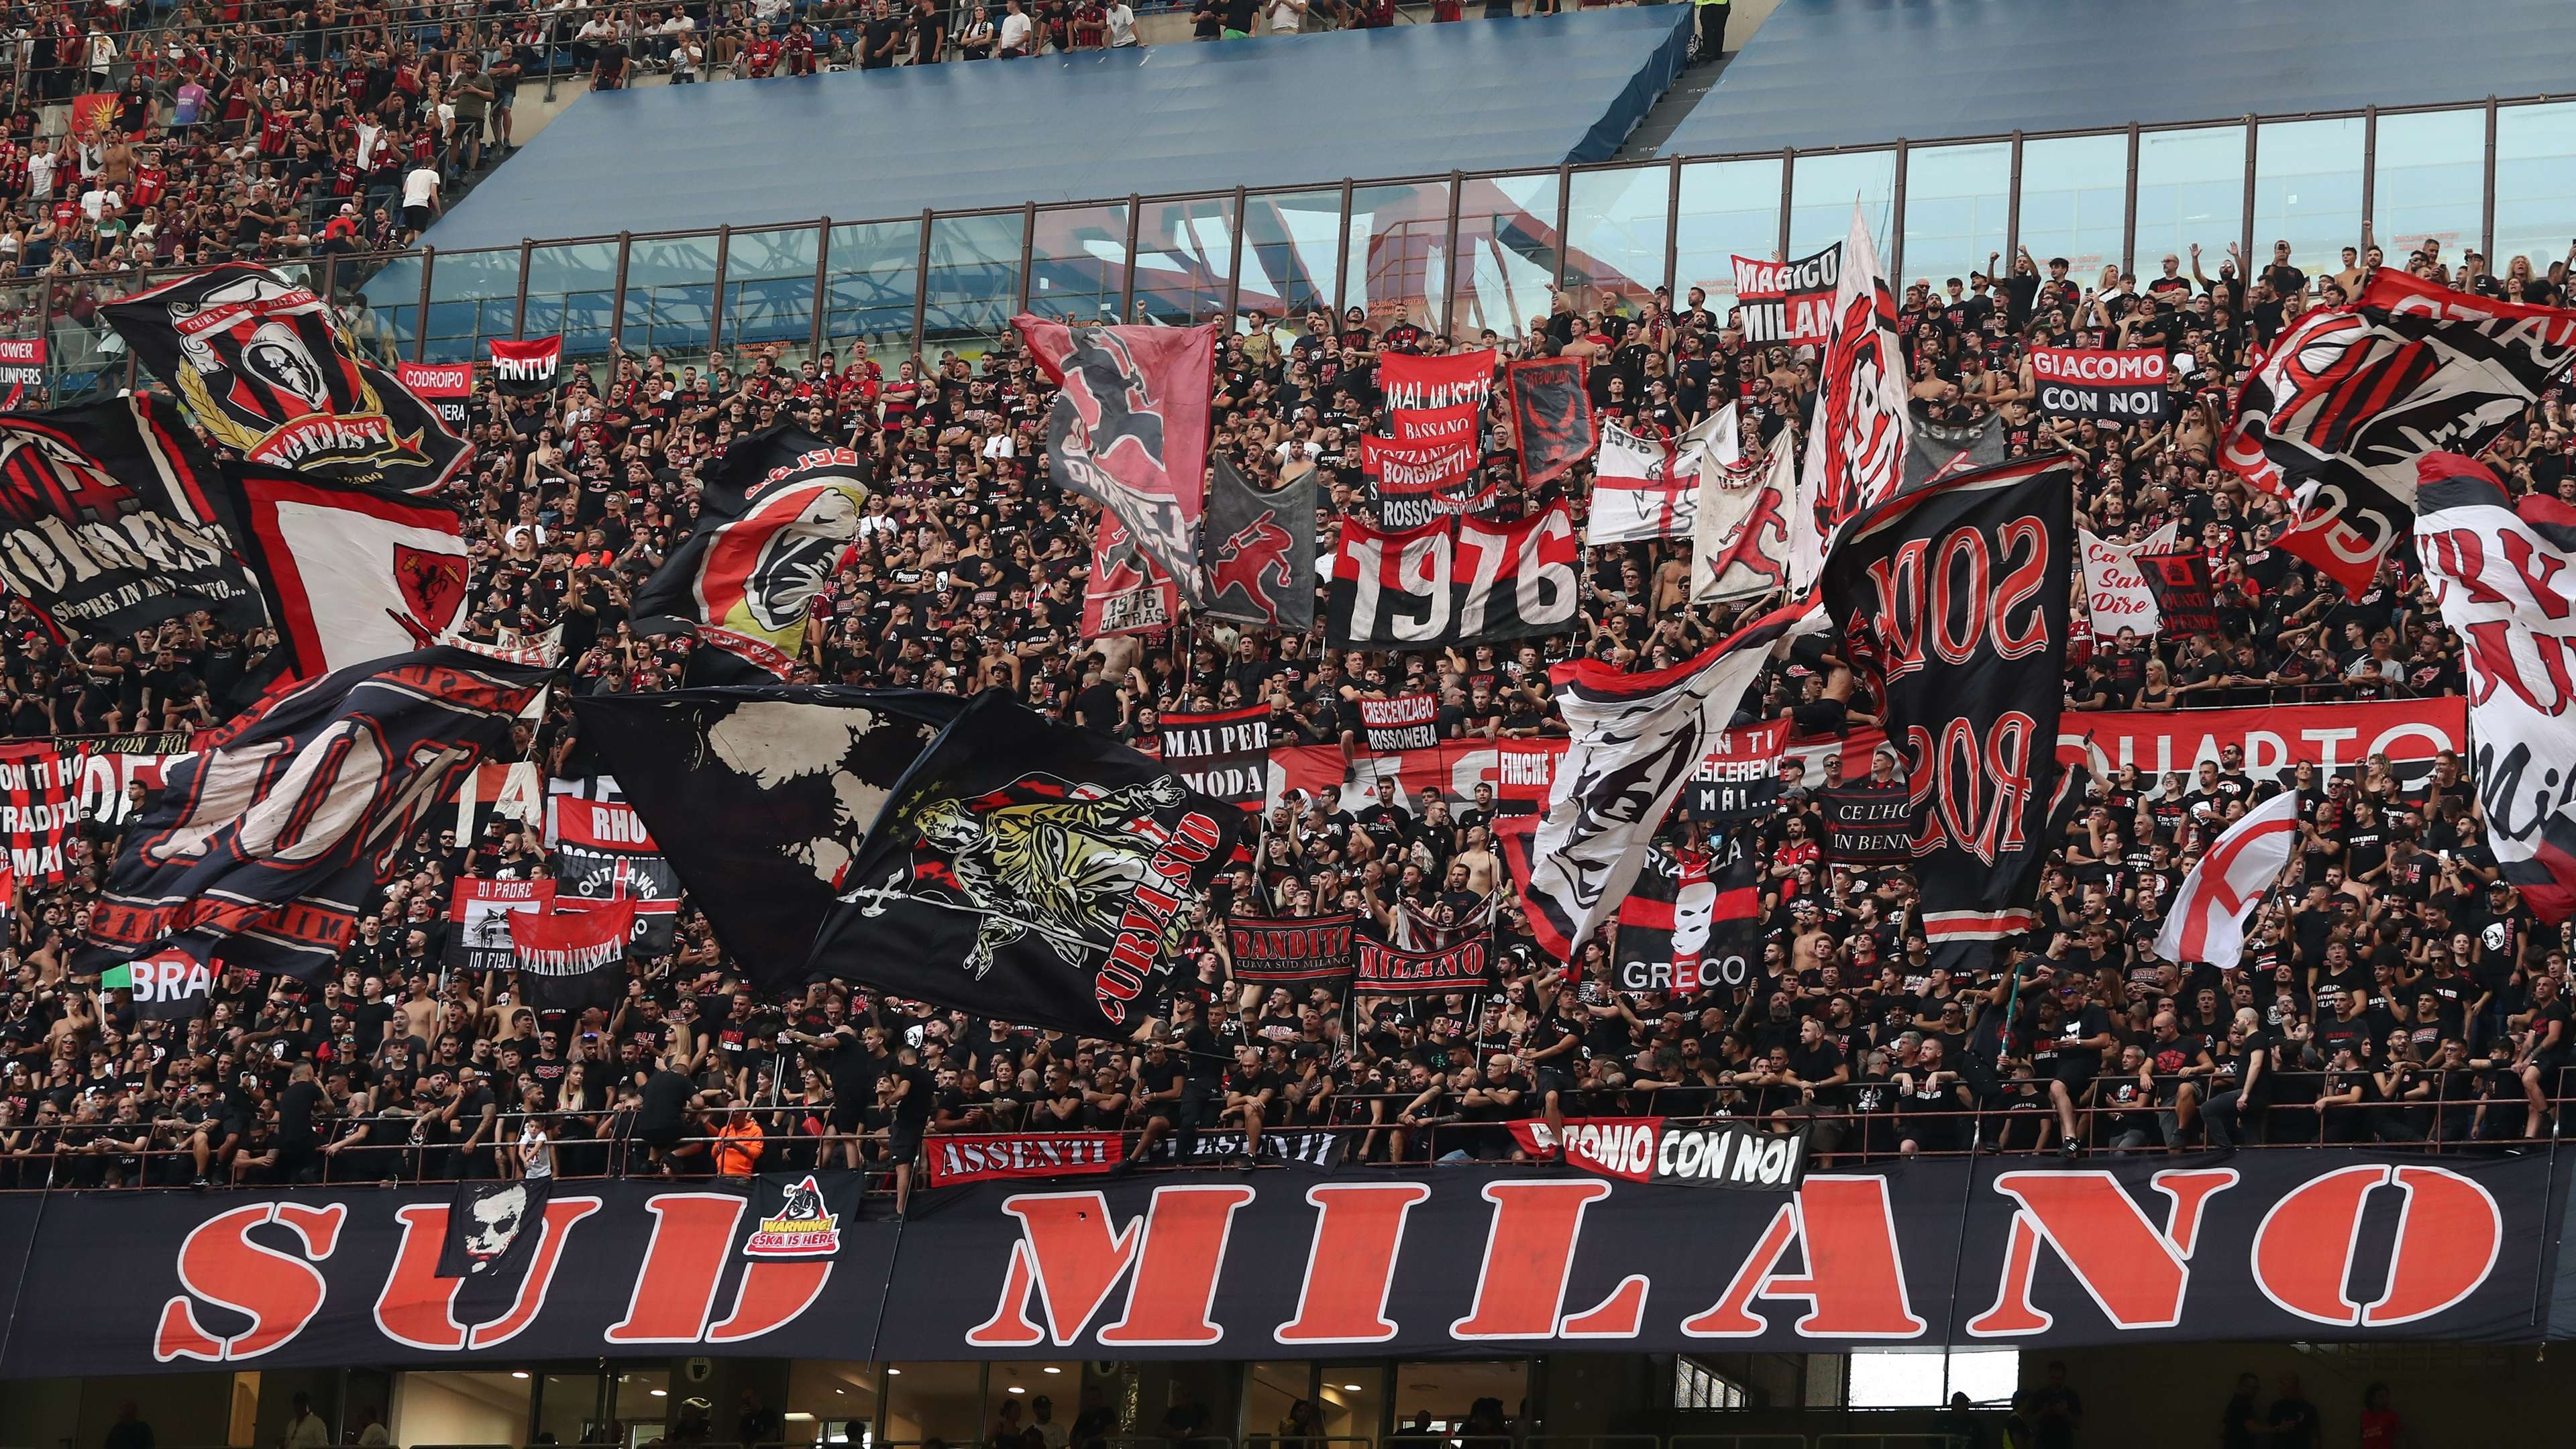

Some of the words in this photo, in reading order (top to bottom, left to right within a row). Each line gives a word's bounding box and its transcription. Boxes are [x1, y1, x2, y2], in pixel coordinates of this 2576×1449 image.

[1737, 248, 1836, 293] MAGICO
[268, 291, 313, 309] MILANO
[406, 370, 463, 388] CODROIPO
[2034, 352, 2164, 380] GIACOMO
[2043, 387, 2098, 412] CON
[2109, 391, 2159, 415] NOI
[1405, 418, 1469, 440] BASSANO
[1605, 425, 1651, 454] 1976
[1383, 449, 1465, 484] BORGHETTI
[2088, 543, 2121, 564] Ça
[1346, 507, 1577, 642] 1976
[2098, 569, 2148, 589] San
[117, 582, 143, 607] IN
[1110, 588, 1157, 616] 1976
[2091, 592, 2149, 614] Dire
[1102, 608, 1166, 631] ULTRAS
[1362, 698, 1434, 725] CRESCENZAGO
[112, 736, 148, 752] CON
[154, 735, 189, 755] NOI
[1165, 729, 1212, 757] MAI
[1220, 720, 1269, 753] PER
[1368, 724, 1438, 751] ROSSONERA
[1746, 729, 1773, 753] TI
[31, 762, 52, 790] TI
[58, 753, 84, 789] HO
[1180, 766, 1264, 797] MODA
[1500, 749, 1548, 786] FINCHÈ
[592, 806, 648, 844] RHO
[1839, 805, 1860, 820] CE
[1834, 834, 1851, 851] IN
[2349, 835, 2379, 843] BANDITI
[12, 845, 64, 877] MAI
[578, 858, 659, 900] OUTLAWS
[1095, 883, 1181, 1025] CURVA
[1150, 811, 1220, 888] SUD
[1231, 926, 1351, 960] BANDITI
[1236, 959, 1274, 969] CURVA
[1275, 959, 1301, 969] SUD
[1303, 955, 1350, 968] MILANO
[1359, 943, 1485, 979] MILANO
[1623, 955, 1746, 989] GRECO
[133, 961, 211, 1004] BRA
[939, 1140, 1107, 1176] ASSENTI
[1657, 1129, 1732, 1179] CON
[1730, 1134, 1801, 1185] NOI
[763, 1218, 832, 1232] WARNING!
[787, 1234, 801, 1246] IS
[802, 1232, 837, 1246] HERE
[154, 1192, 837, 1362] SUD
[964, 1164, 2504, 1348] MILANO
